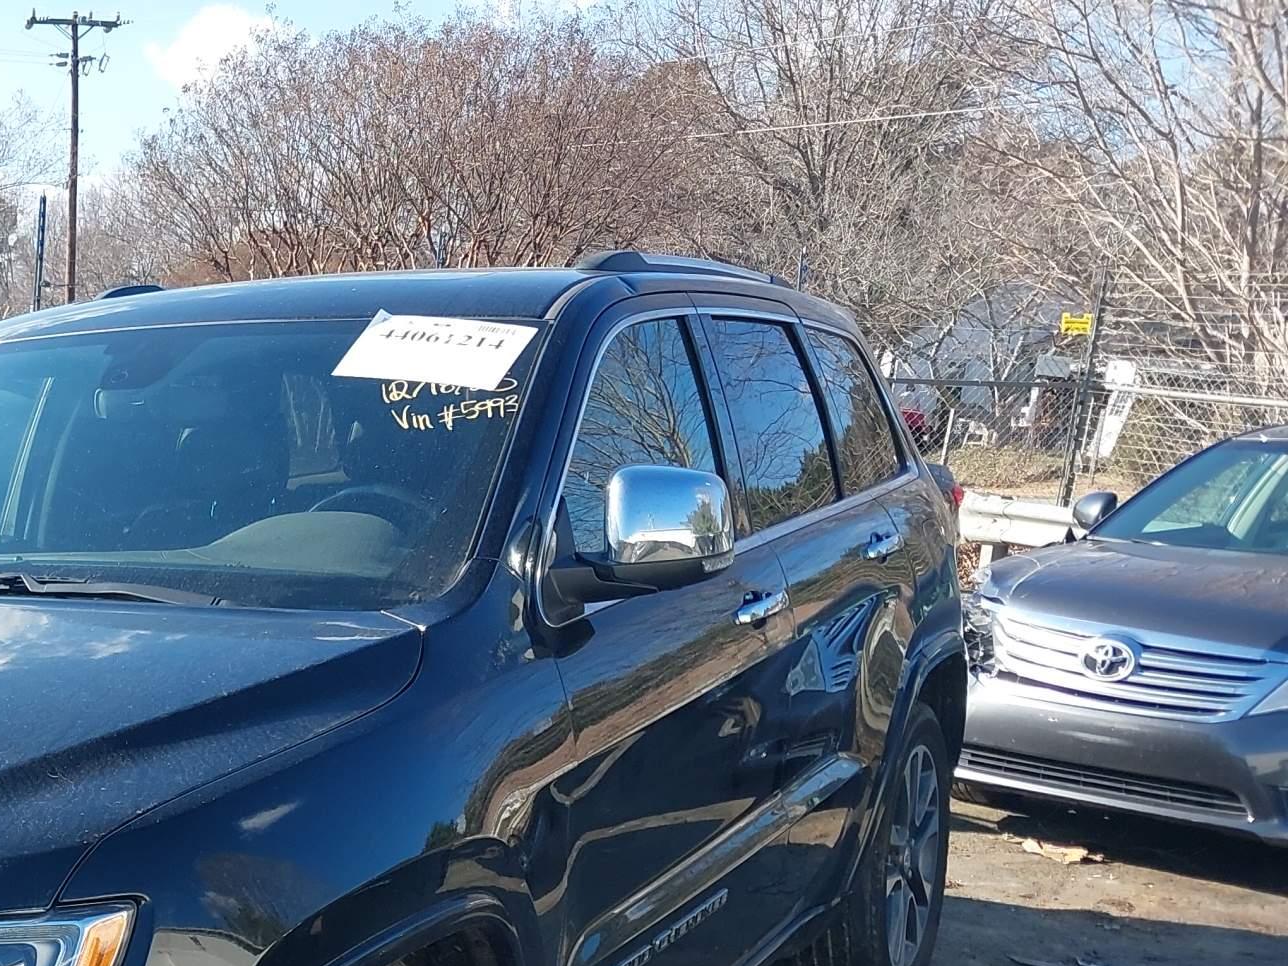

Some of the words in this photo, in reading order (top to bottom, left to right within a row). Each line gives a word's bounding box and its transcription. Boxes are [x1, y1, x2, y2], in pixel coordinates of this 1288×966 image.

[380, 328, 506, 350] 44061214
[391, 404, 434, 430] Vin
[437, 394, 519, 431] #5993
